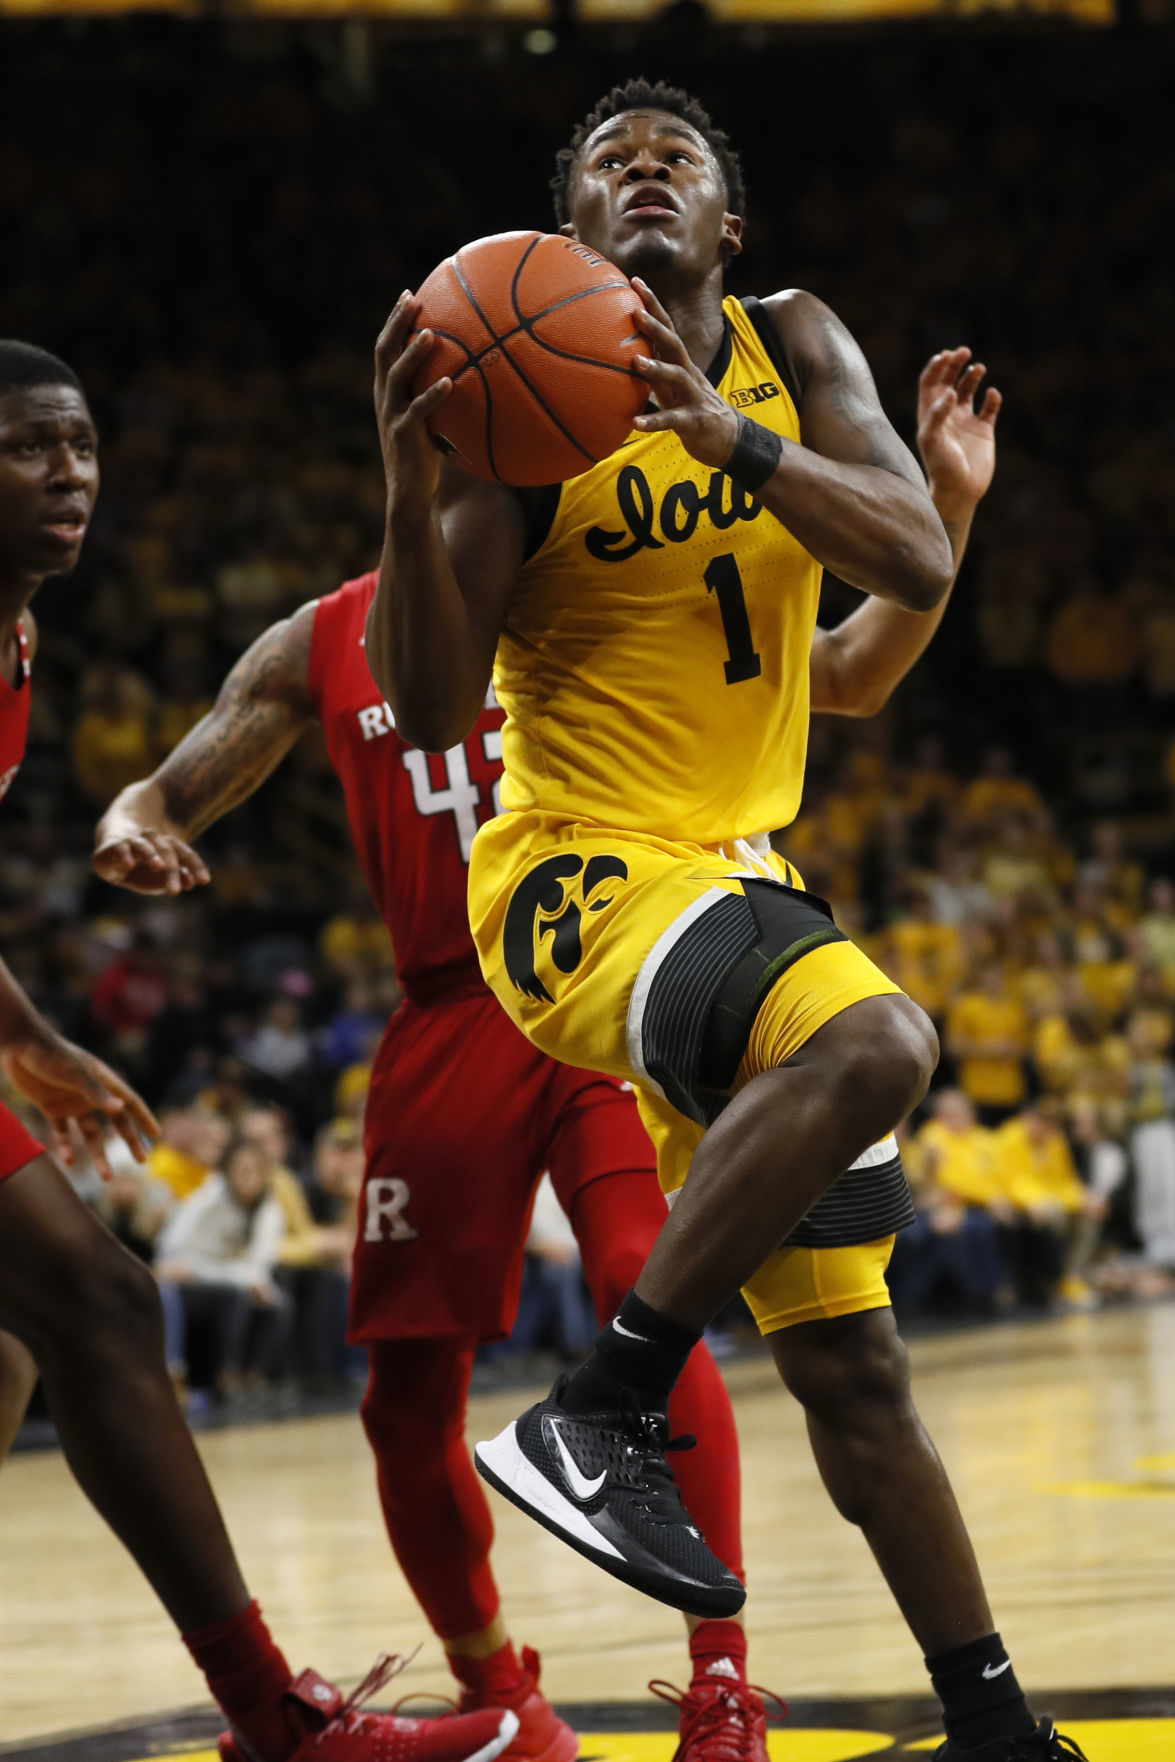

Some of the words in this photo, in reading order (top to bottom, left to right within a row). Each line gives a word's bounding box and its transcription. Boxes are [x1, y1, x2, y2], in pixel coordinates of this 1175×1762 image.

[730, 382, 780, 408] BIG
[585, 465, 763, 562] Iow
[703, 552, 761, 685] 1
[364, 1178, 418, 1242] R
